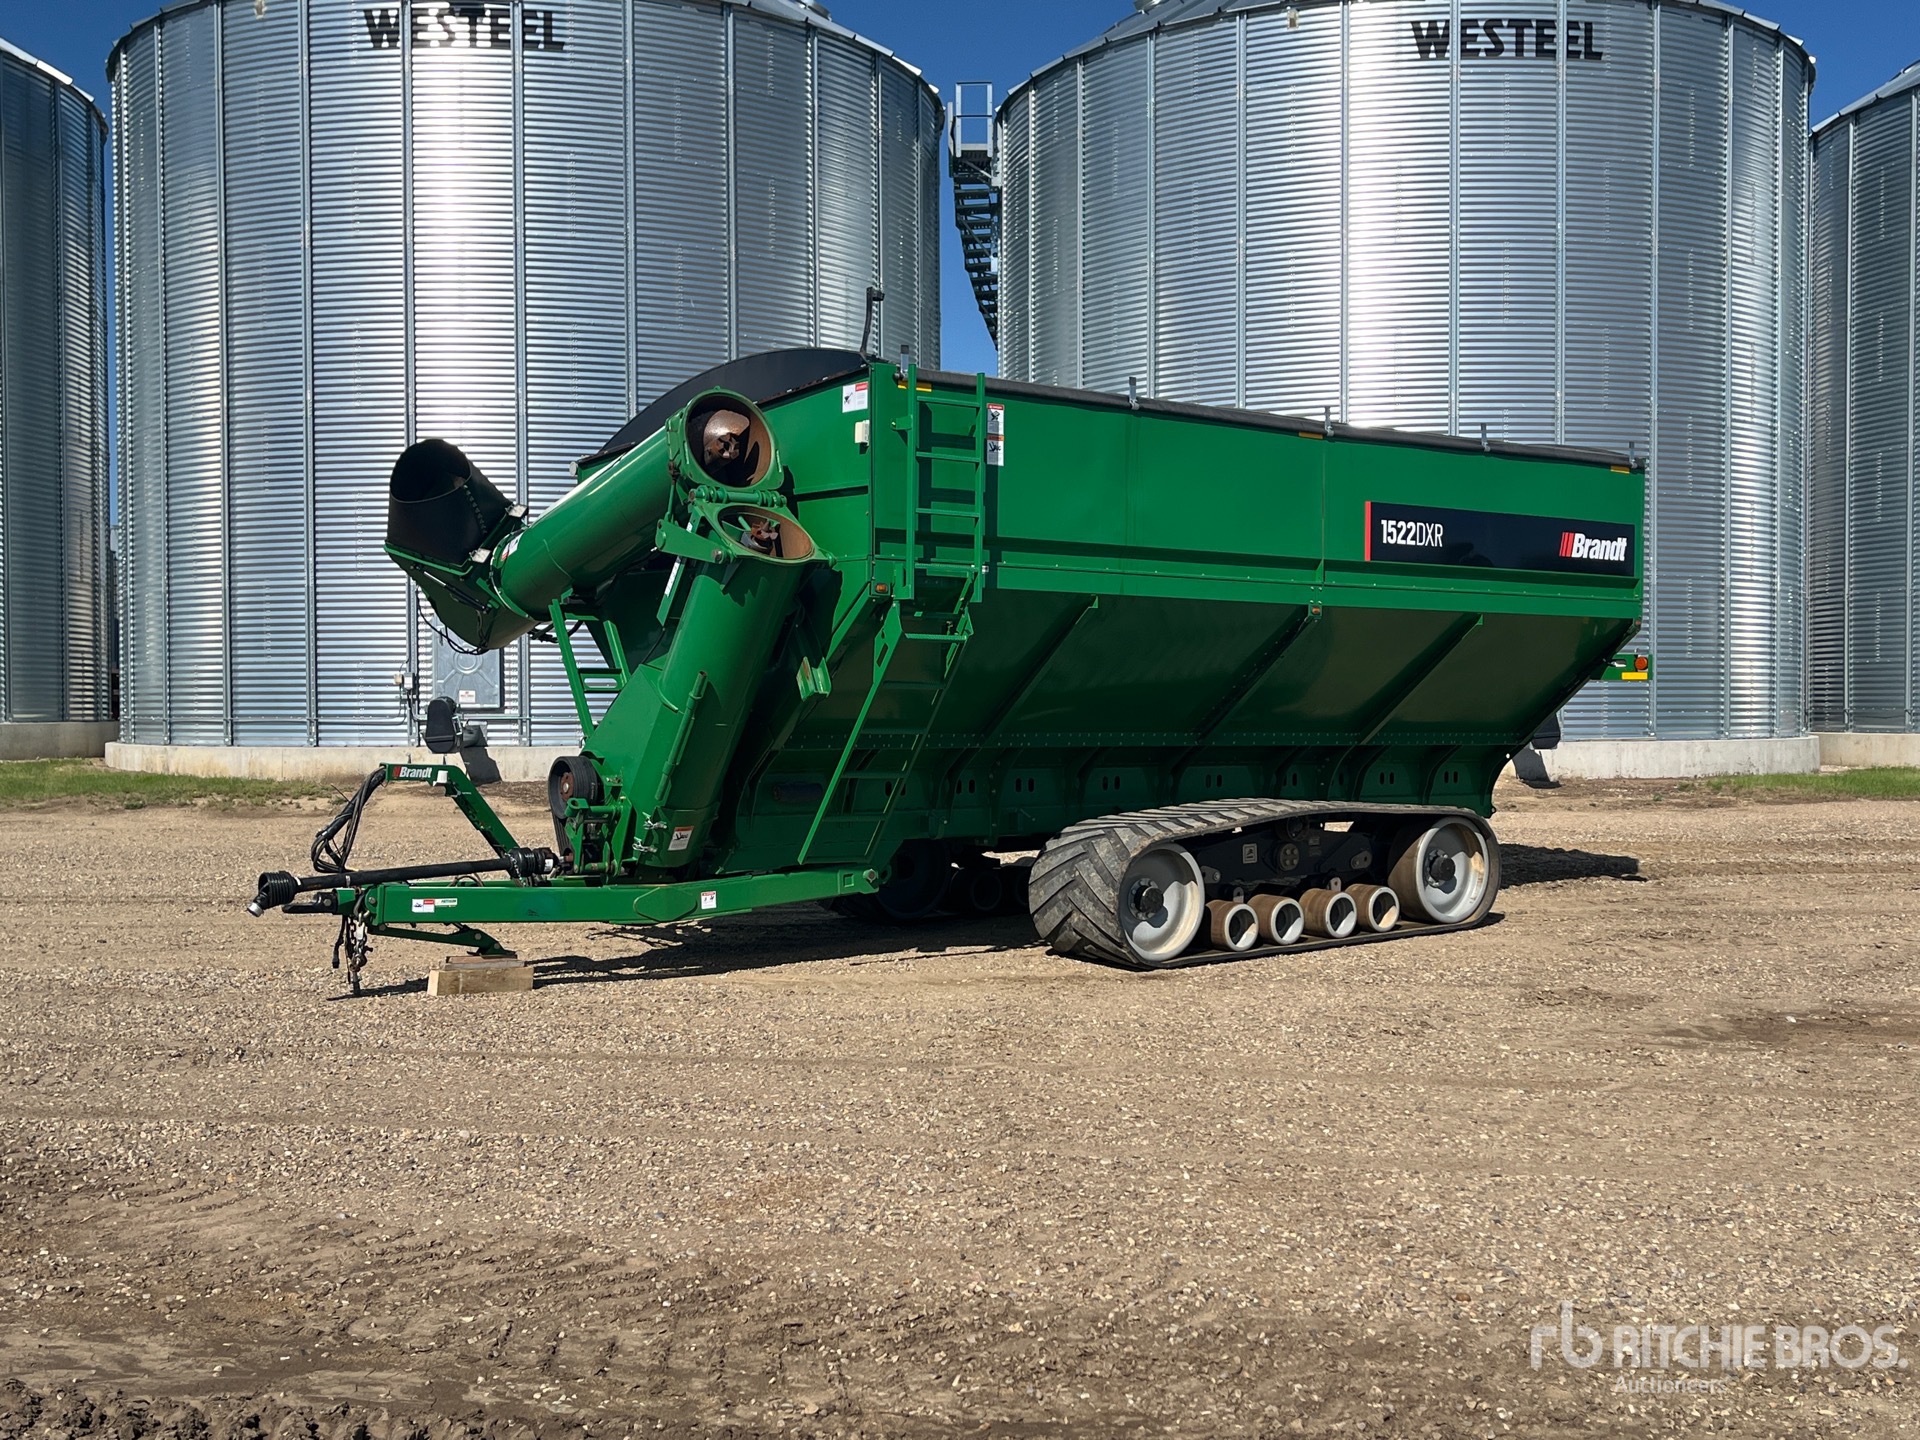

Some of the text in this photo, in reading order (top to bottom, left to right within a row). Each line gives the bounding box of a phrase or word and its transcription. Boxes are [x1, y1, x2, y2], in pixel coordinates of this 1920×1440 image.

[364, 8, 565, 50] WESTEEL
[1410, 19, 1603, 60] WESTEEL
[1381, 519, 1443, 547] 1522DXR
[1571, 533, 1627, 561] Brandt
[399, 766, 432, 778] Brandt
